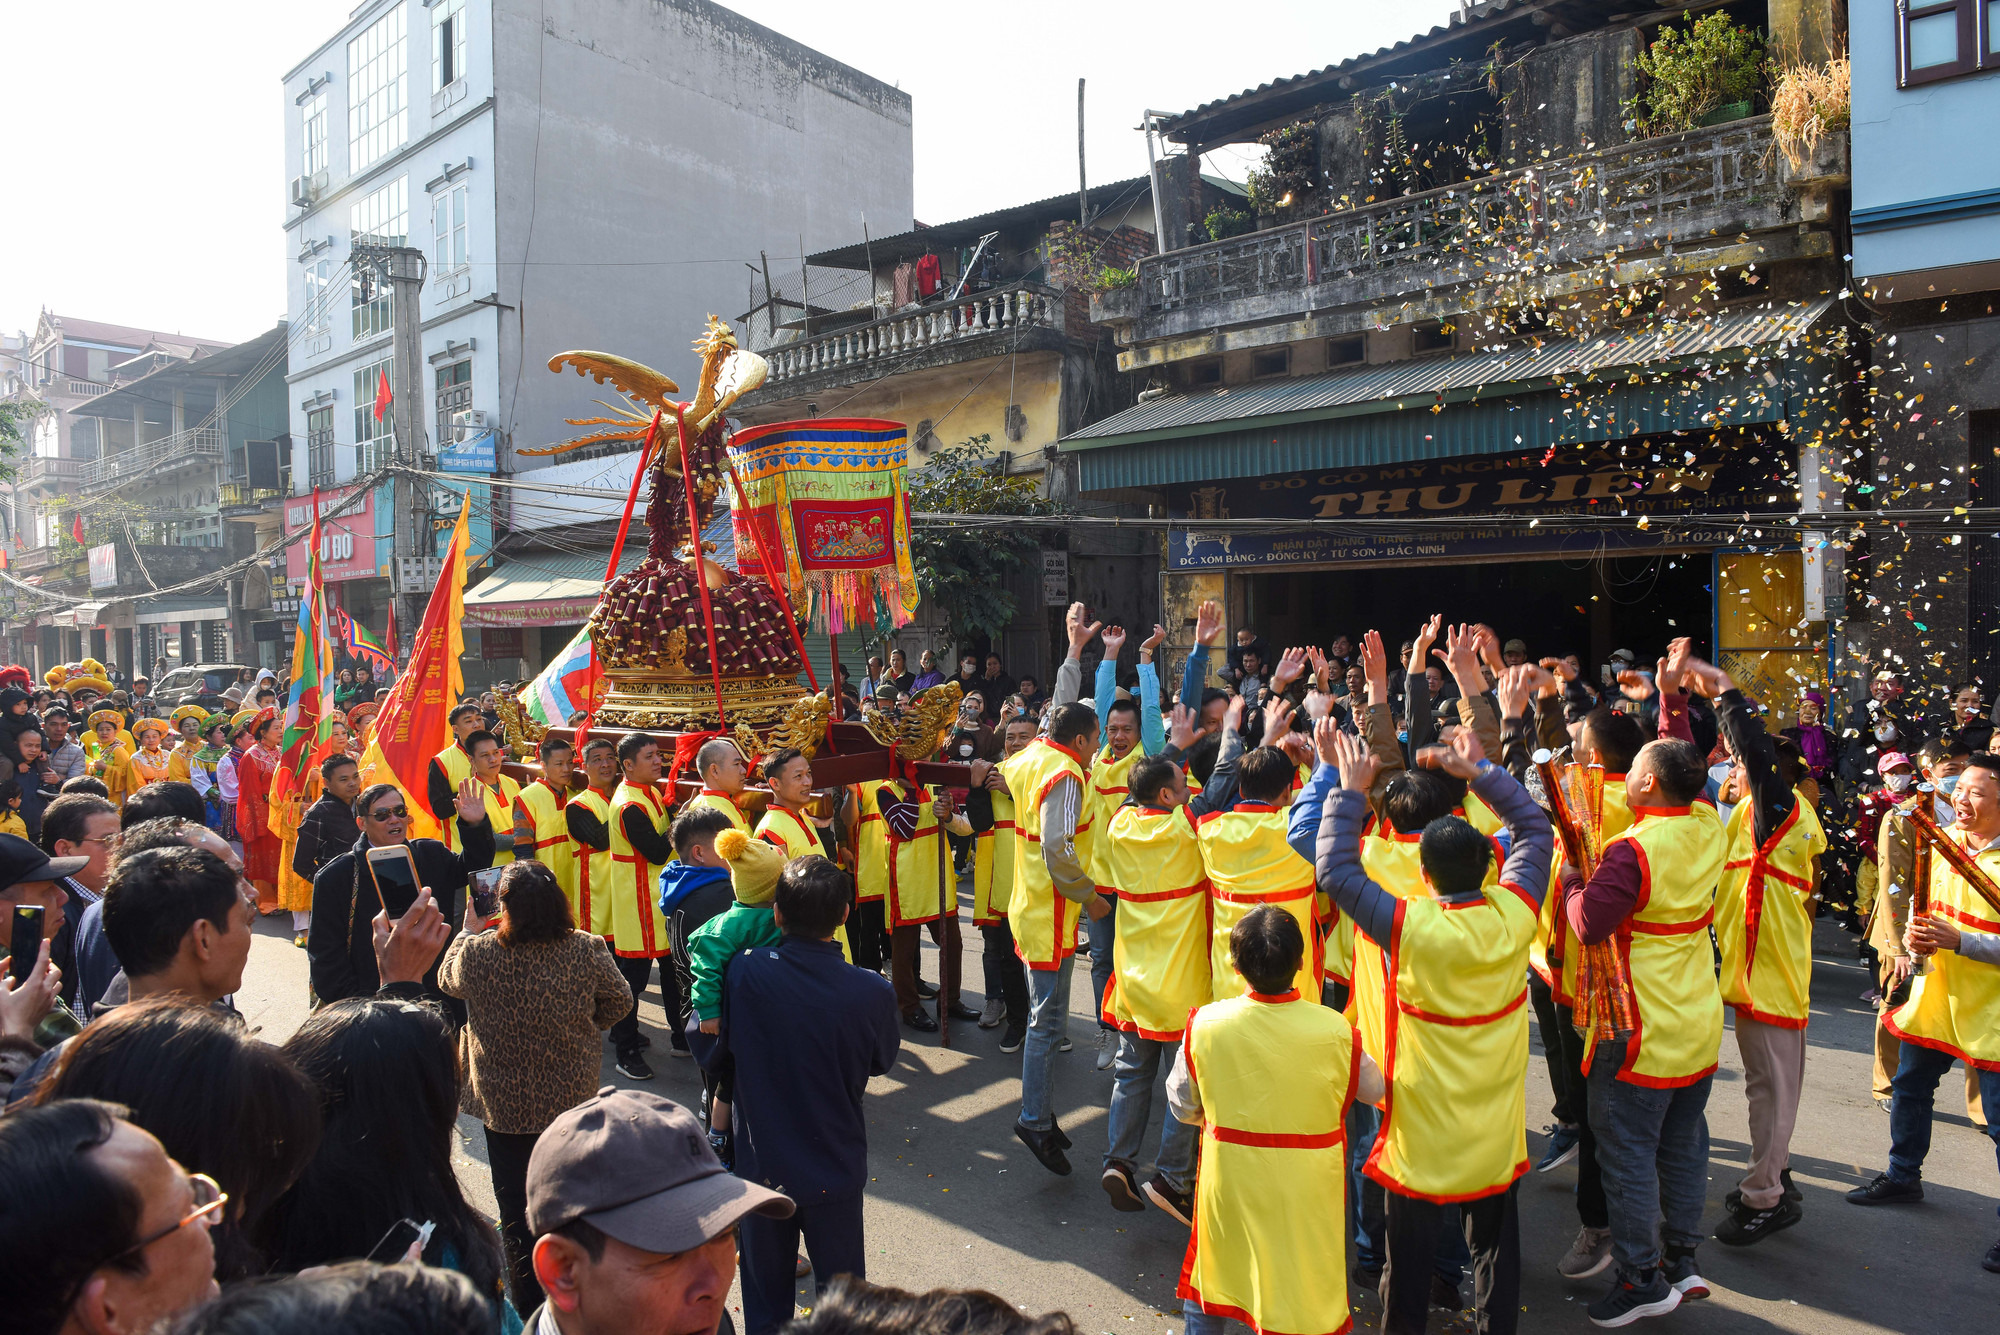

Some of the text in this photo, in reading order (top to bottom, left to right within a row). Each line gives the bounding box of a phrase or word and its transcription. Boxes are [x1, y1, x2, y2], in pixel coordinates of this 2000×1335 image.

[1309, 463, 1725, 518] THU LIÊN
[1416, 544, 1446, 555] NINH
[529, 607, 550, 620] CAO
[687, 1135, 702, 1156] R
